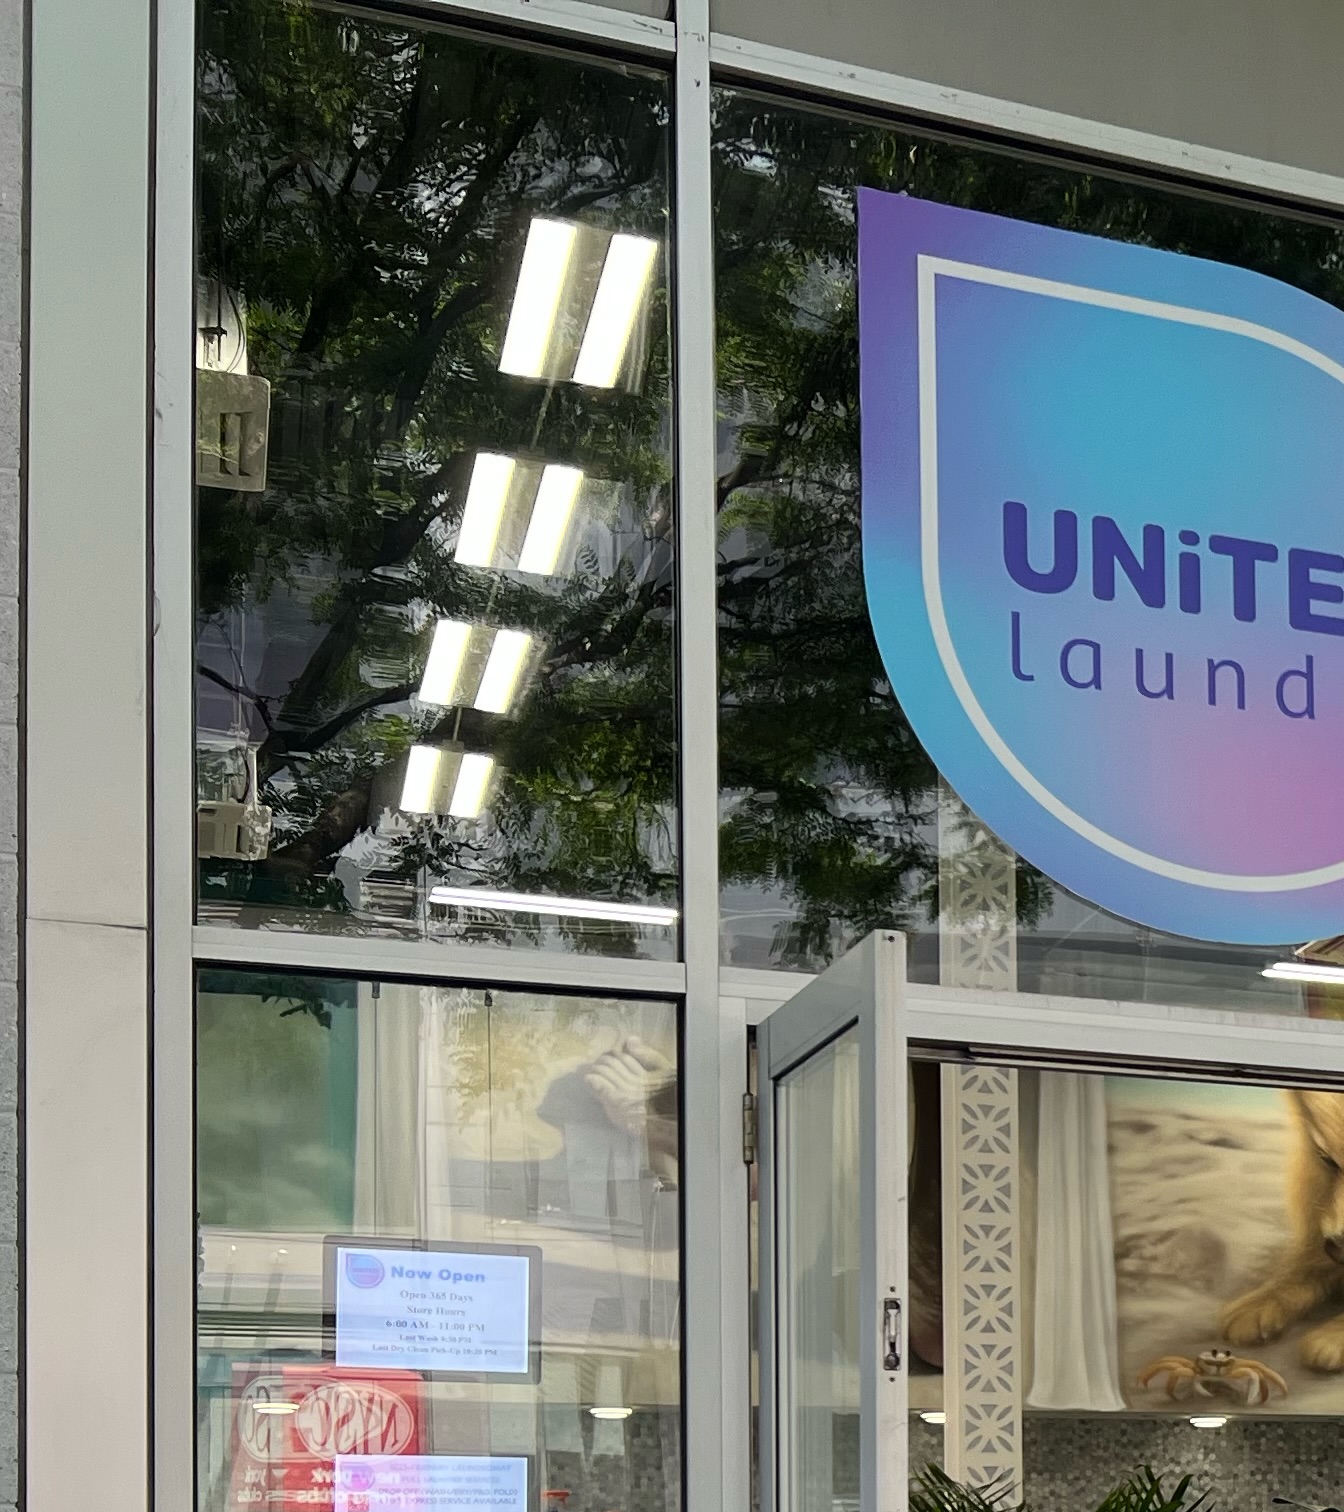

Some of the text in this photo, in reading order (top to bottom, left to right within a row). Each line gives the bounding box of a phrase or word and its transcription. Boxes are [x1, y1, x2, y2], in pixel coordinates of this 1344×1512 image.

[391, 1266, 486, 1284] Now Open
[399, 1290, 427, 1300] Open
[449, 1292, 474, 1304] Days
[406, 1305, 433, 1315] Store
